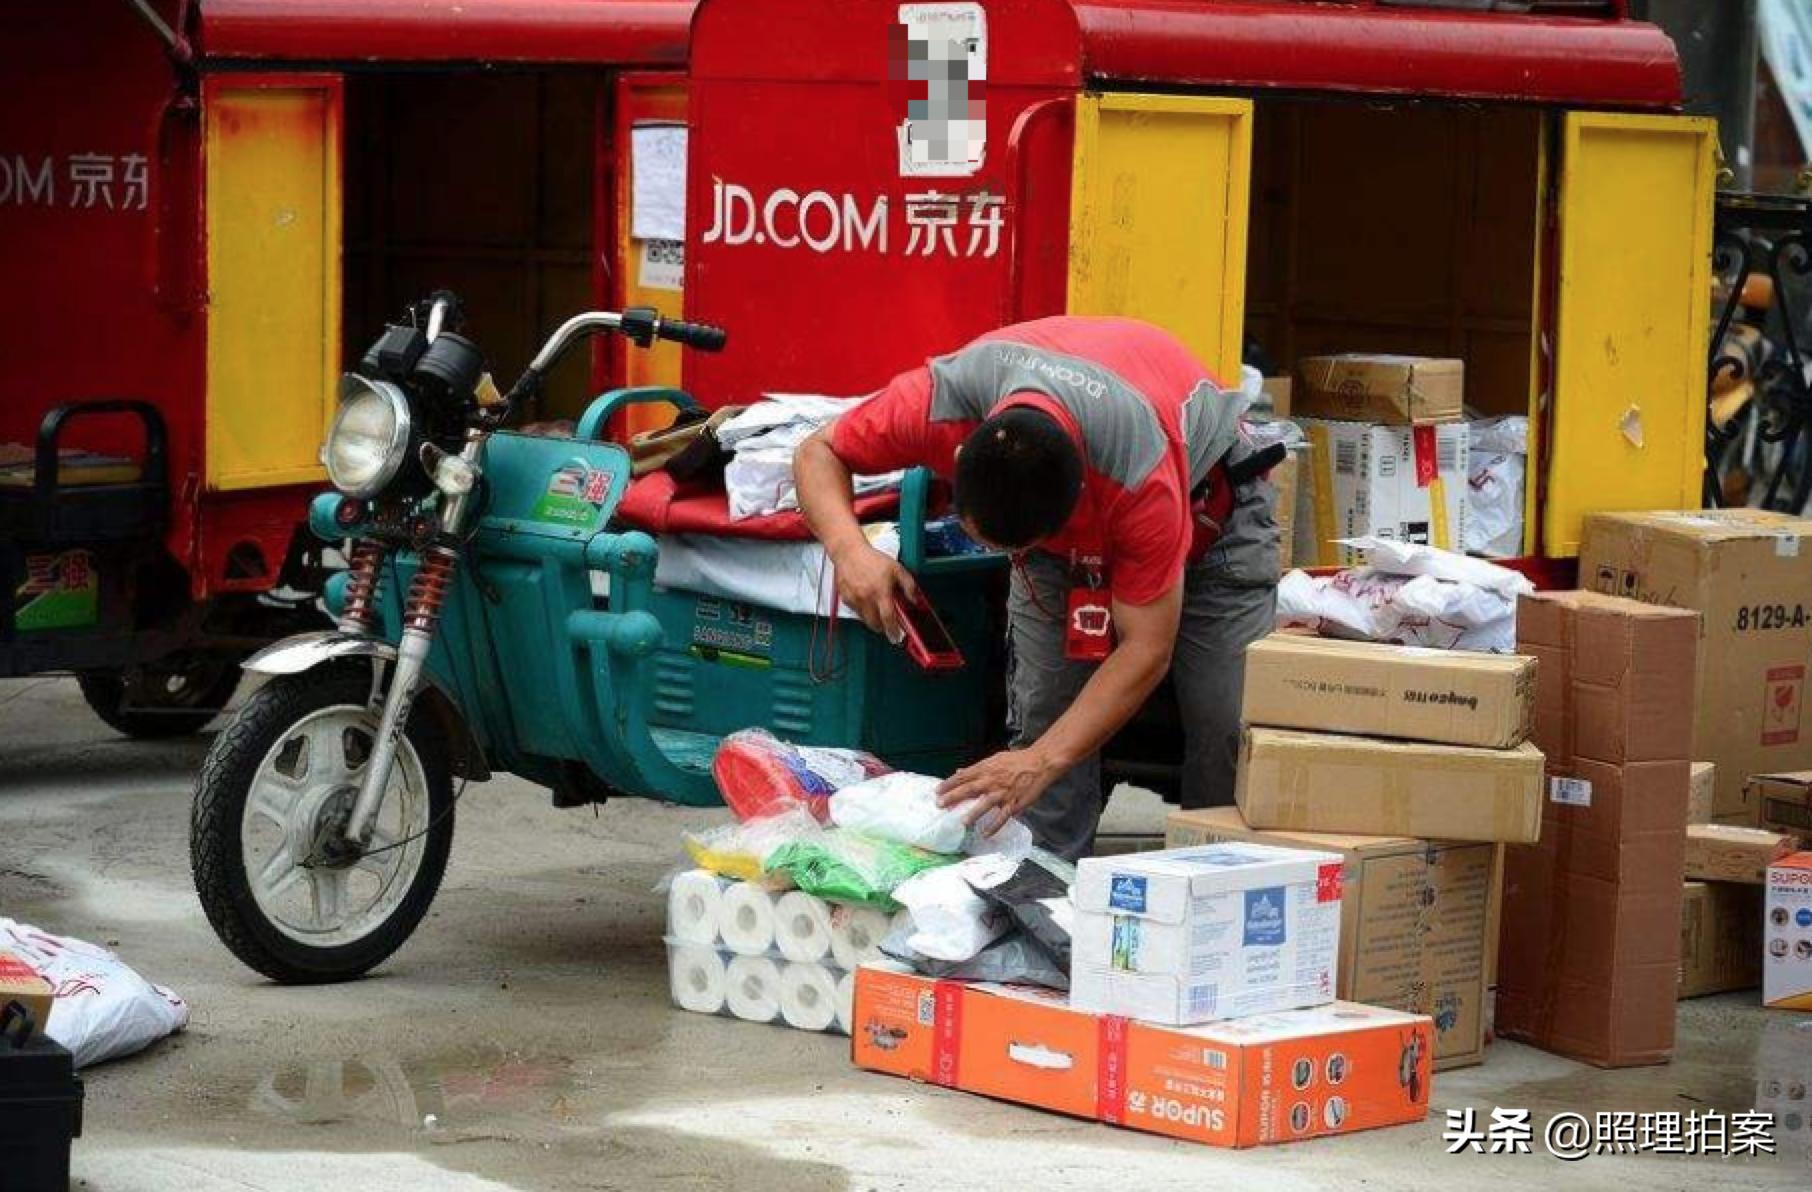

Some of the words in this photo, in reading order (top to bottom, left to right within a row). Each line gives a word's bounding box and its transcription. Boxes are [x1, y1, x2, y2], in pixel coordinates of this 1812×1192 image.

[67, 152, 149, 210] 京东
[703, 180, 889, 253] JD.COM
[905, 189, 1006, 258] 京东
[1151, 1095, 1225, 1131] SUPOR
